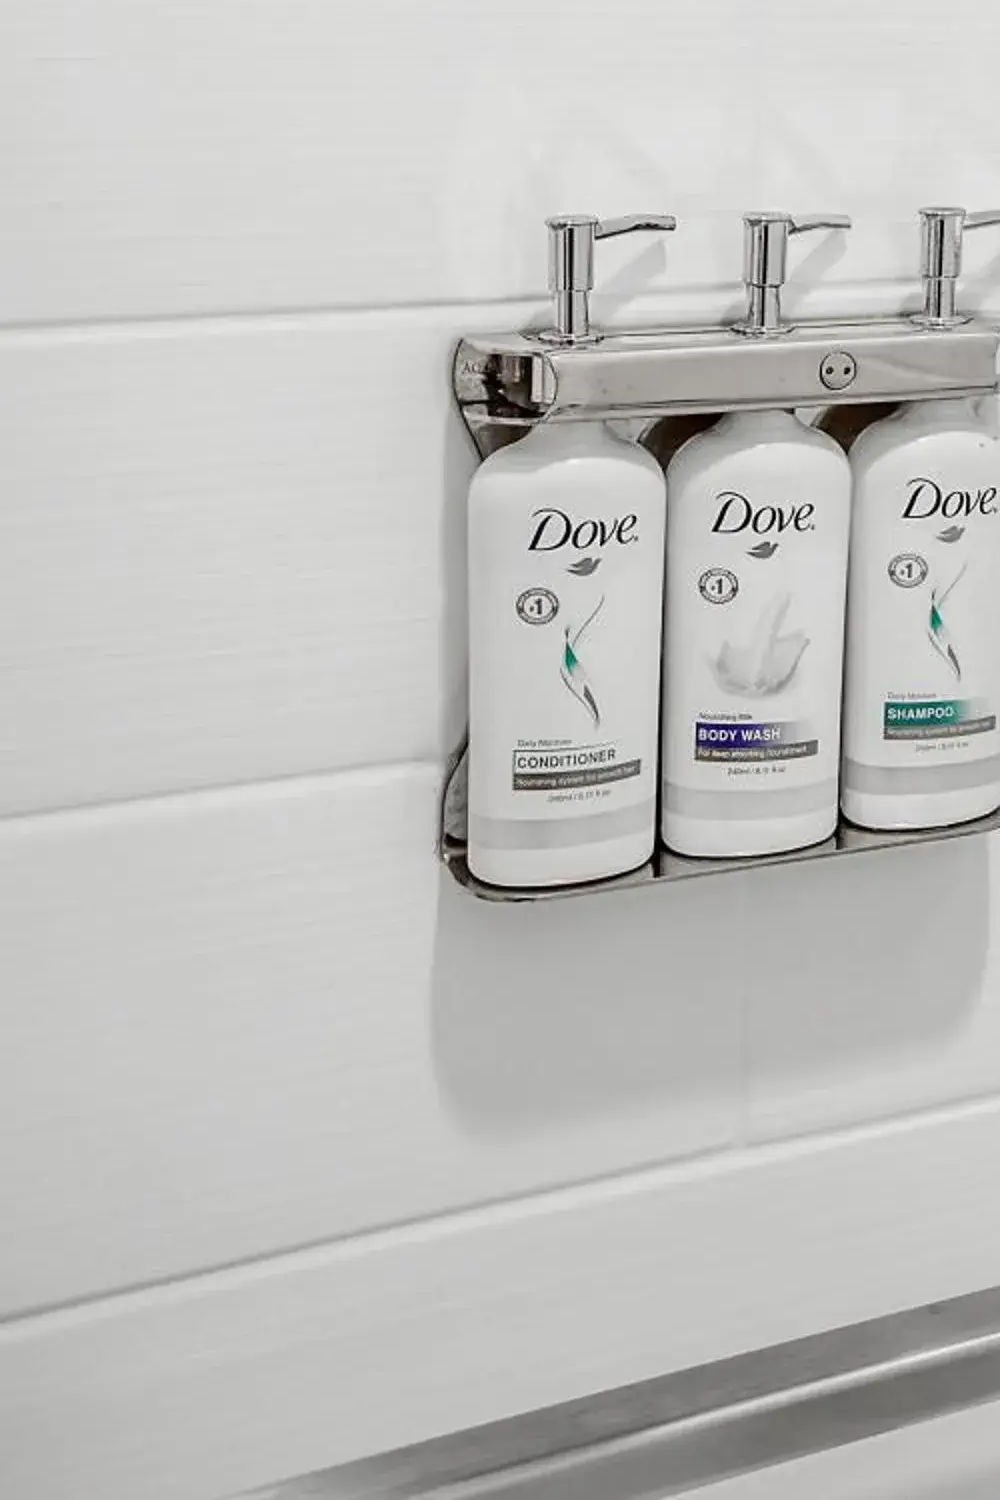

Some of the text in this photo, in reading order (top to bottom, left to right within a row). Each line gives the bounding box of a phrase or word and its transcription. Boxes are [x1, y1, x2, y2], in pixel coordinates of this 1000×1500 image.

[711, 491, 815, 534] Dove
[902, 477, 998, 519] Dove
[528, 507, 638, 551] Dove
[887, 706, 955, 720] SHAMPOO
[698, 726, 781, 741] BODY WASH
[517, 748, 616, 769] CONDITIONER
